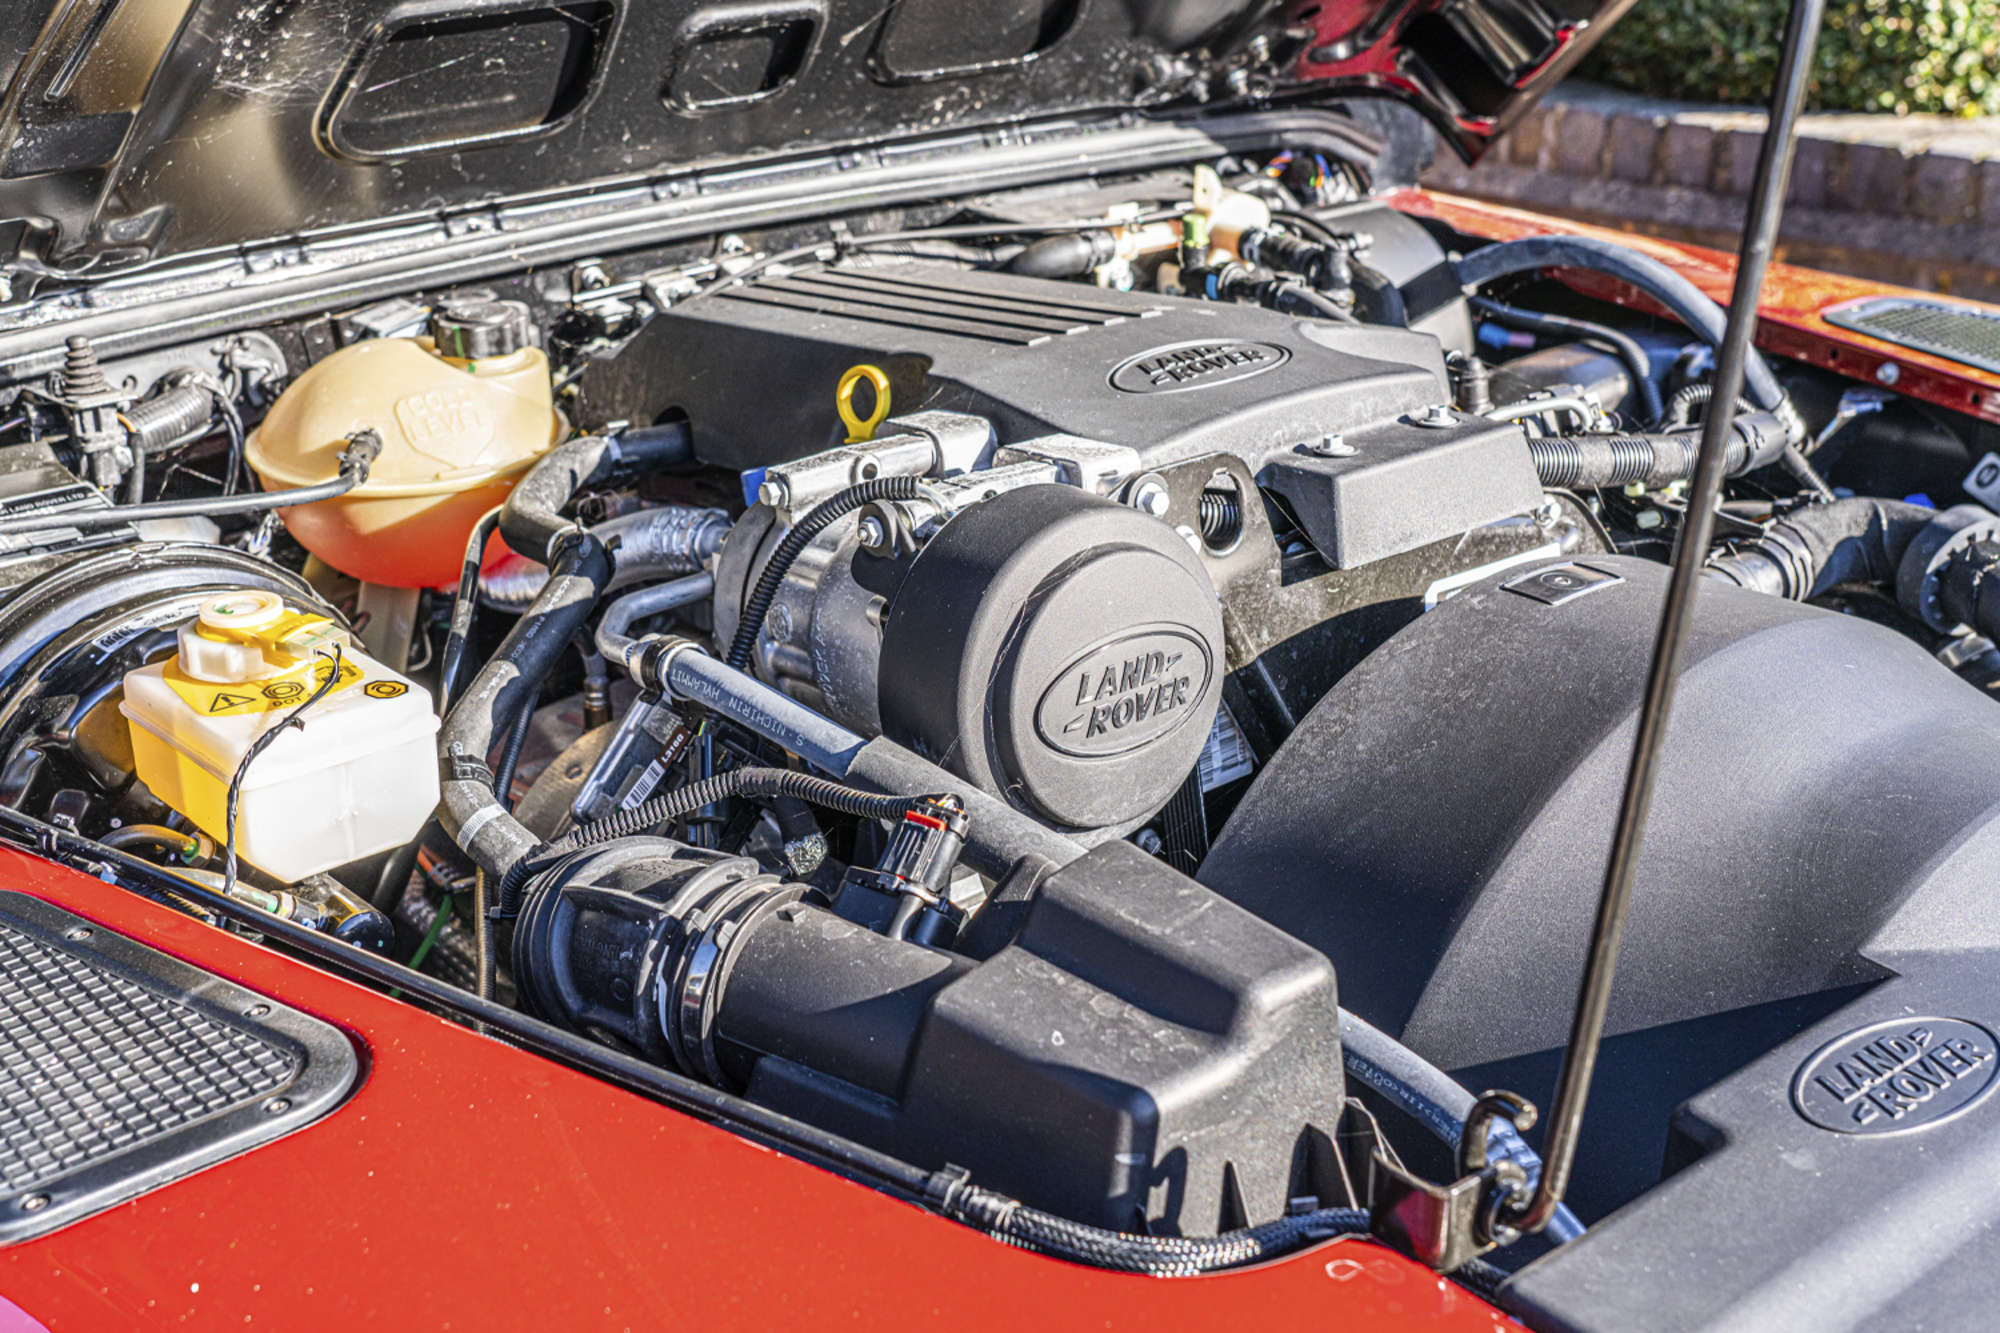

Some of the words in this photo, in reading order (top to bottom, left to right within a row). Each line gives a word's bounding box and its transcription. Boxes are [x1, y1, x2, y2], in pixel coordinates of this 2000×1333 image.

[1136, 345, 1223, 375] LAND
[1166, 350, 1270, 382] ROVER
[1076, 651, 1165, 706] LAND
[728, 697, 787, 737] NICHIRIN
[1086, 676, 1190, 738] ROVER
[1813, 1034, 1923, 1104] LAND
[1864, 1037, 1993, 1119] ROVER
